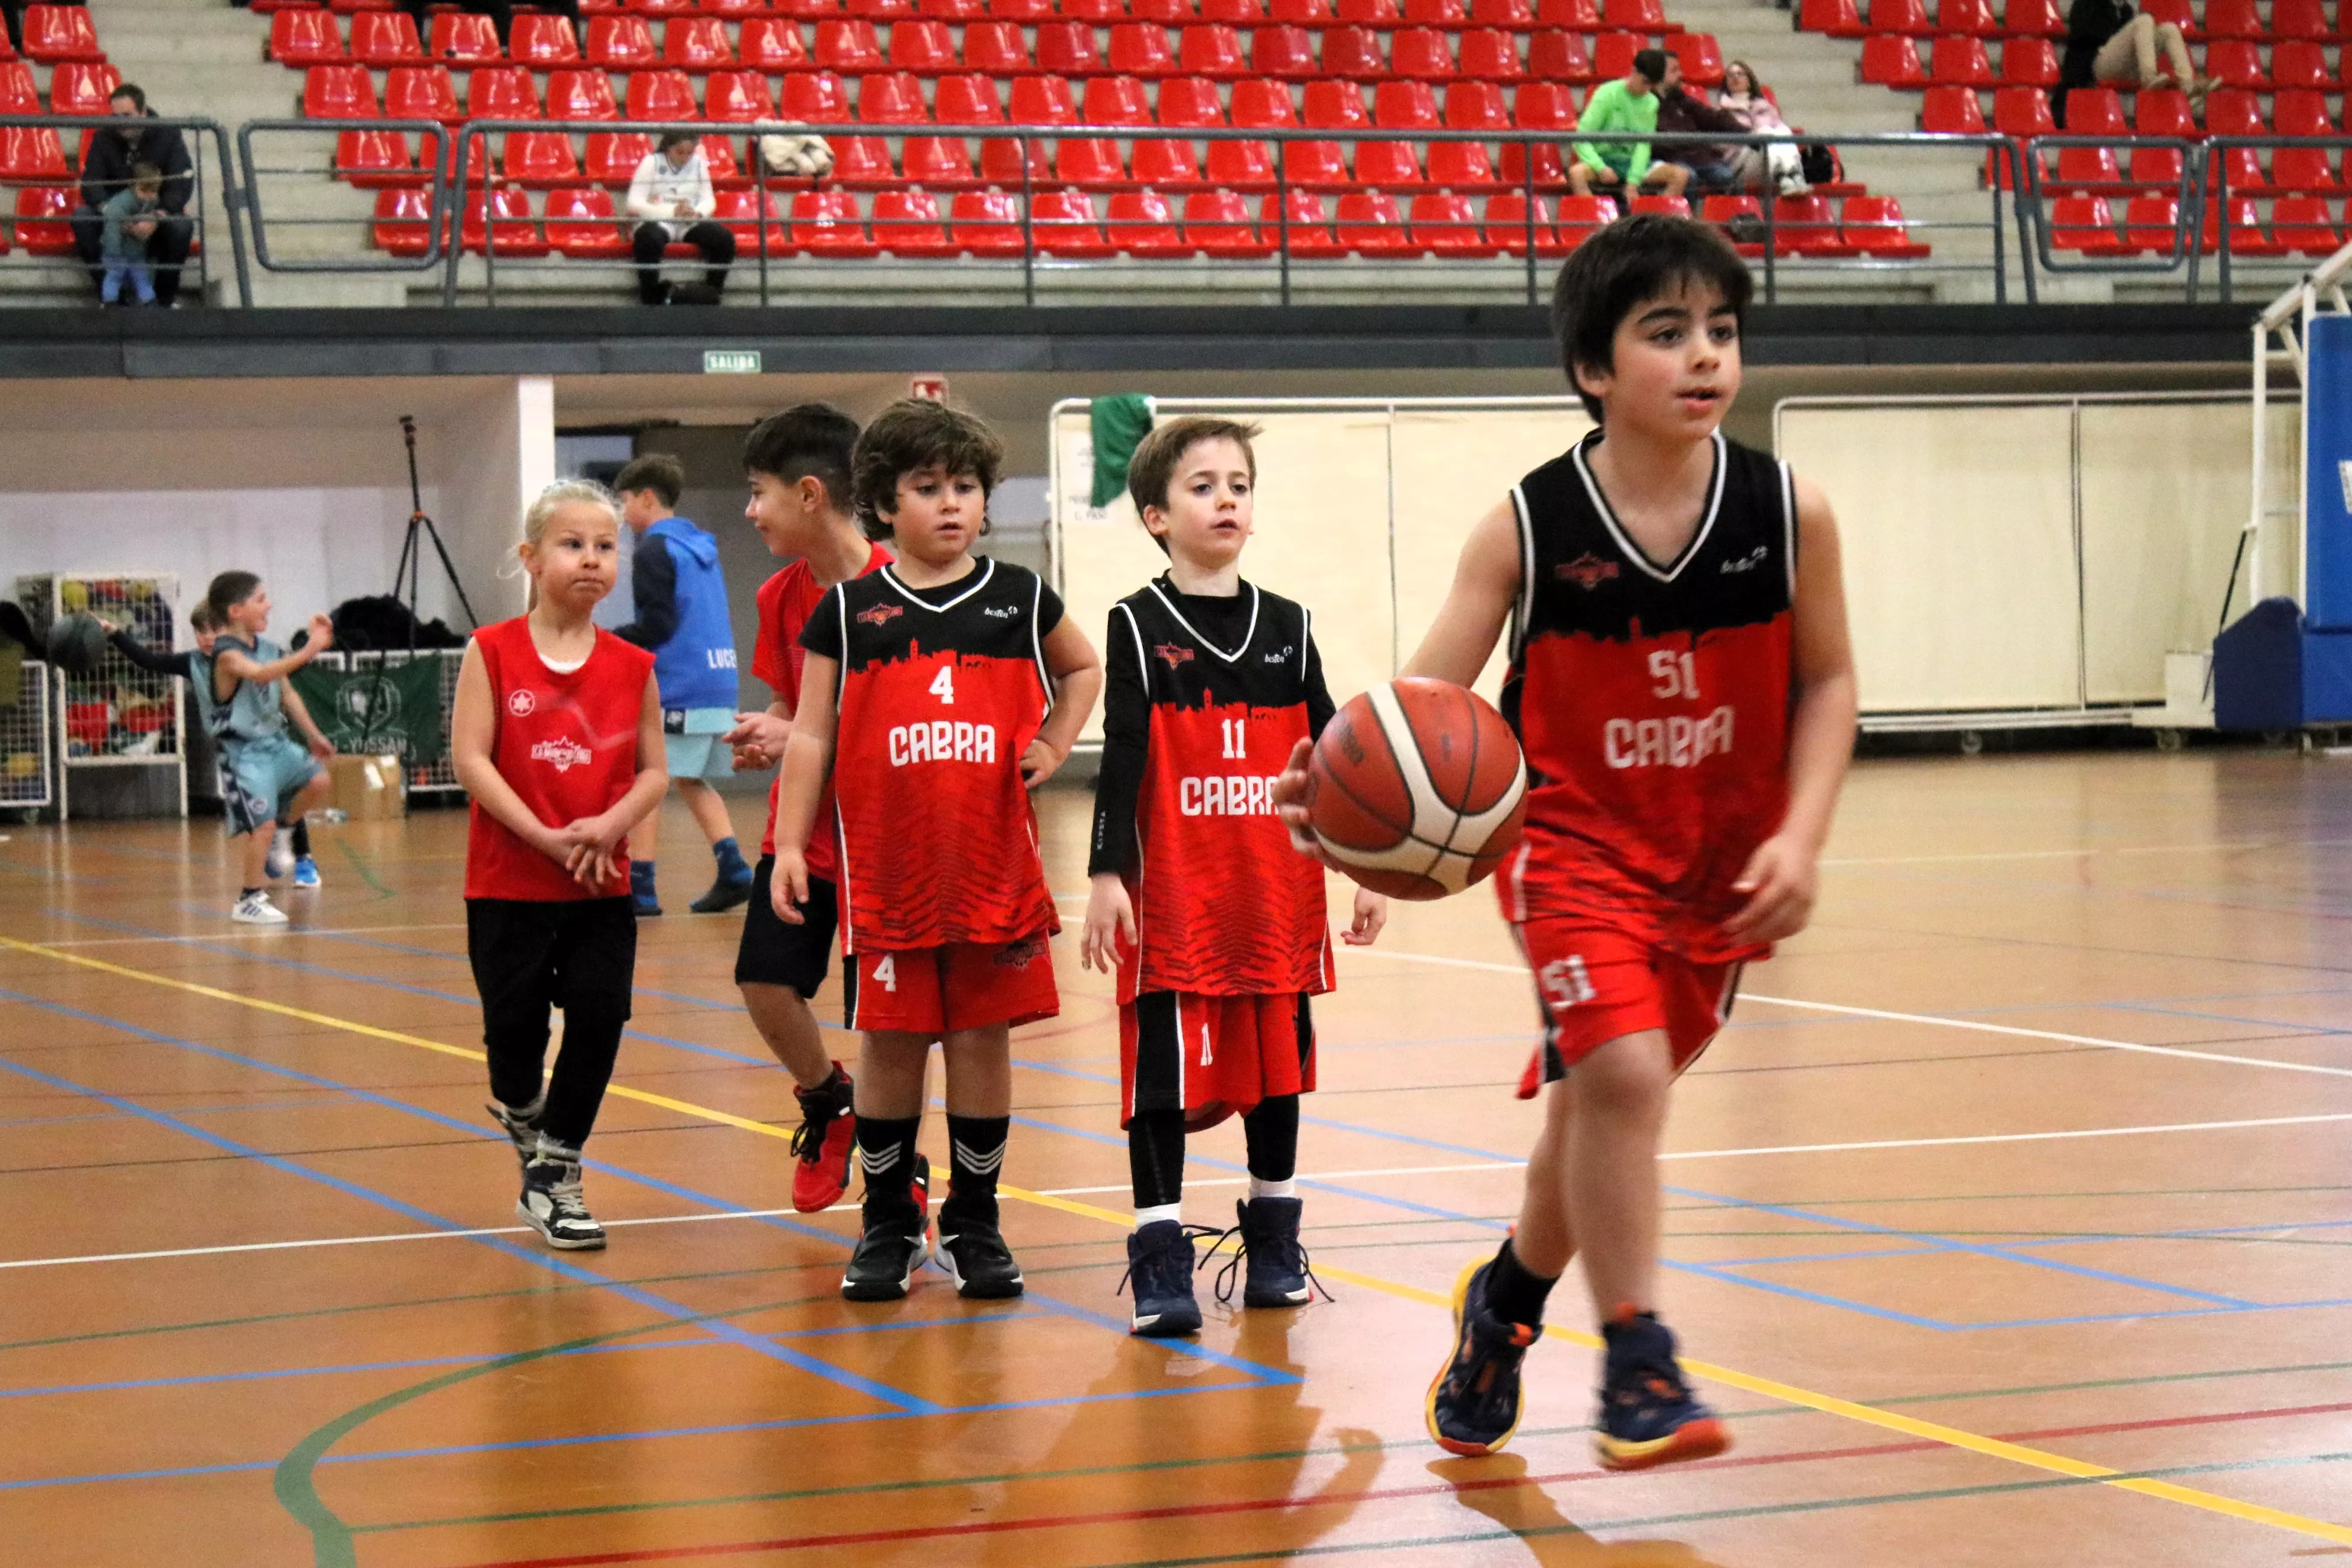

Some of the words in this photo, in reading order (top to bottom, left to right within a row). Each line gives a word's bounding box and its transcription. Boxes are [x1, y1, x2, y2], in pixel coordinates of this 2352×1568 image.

[929, 665, 954, 704] 4
[1648, 650, 1700, 699] 51
[888, 720, 995, 767] CABRA
[1221, 718, 1246, 759] 11
[873, 952, 896, 992] 4
[1541, 955, 1598, 1011] 51
